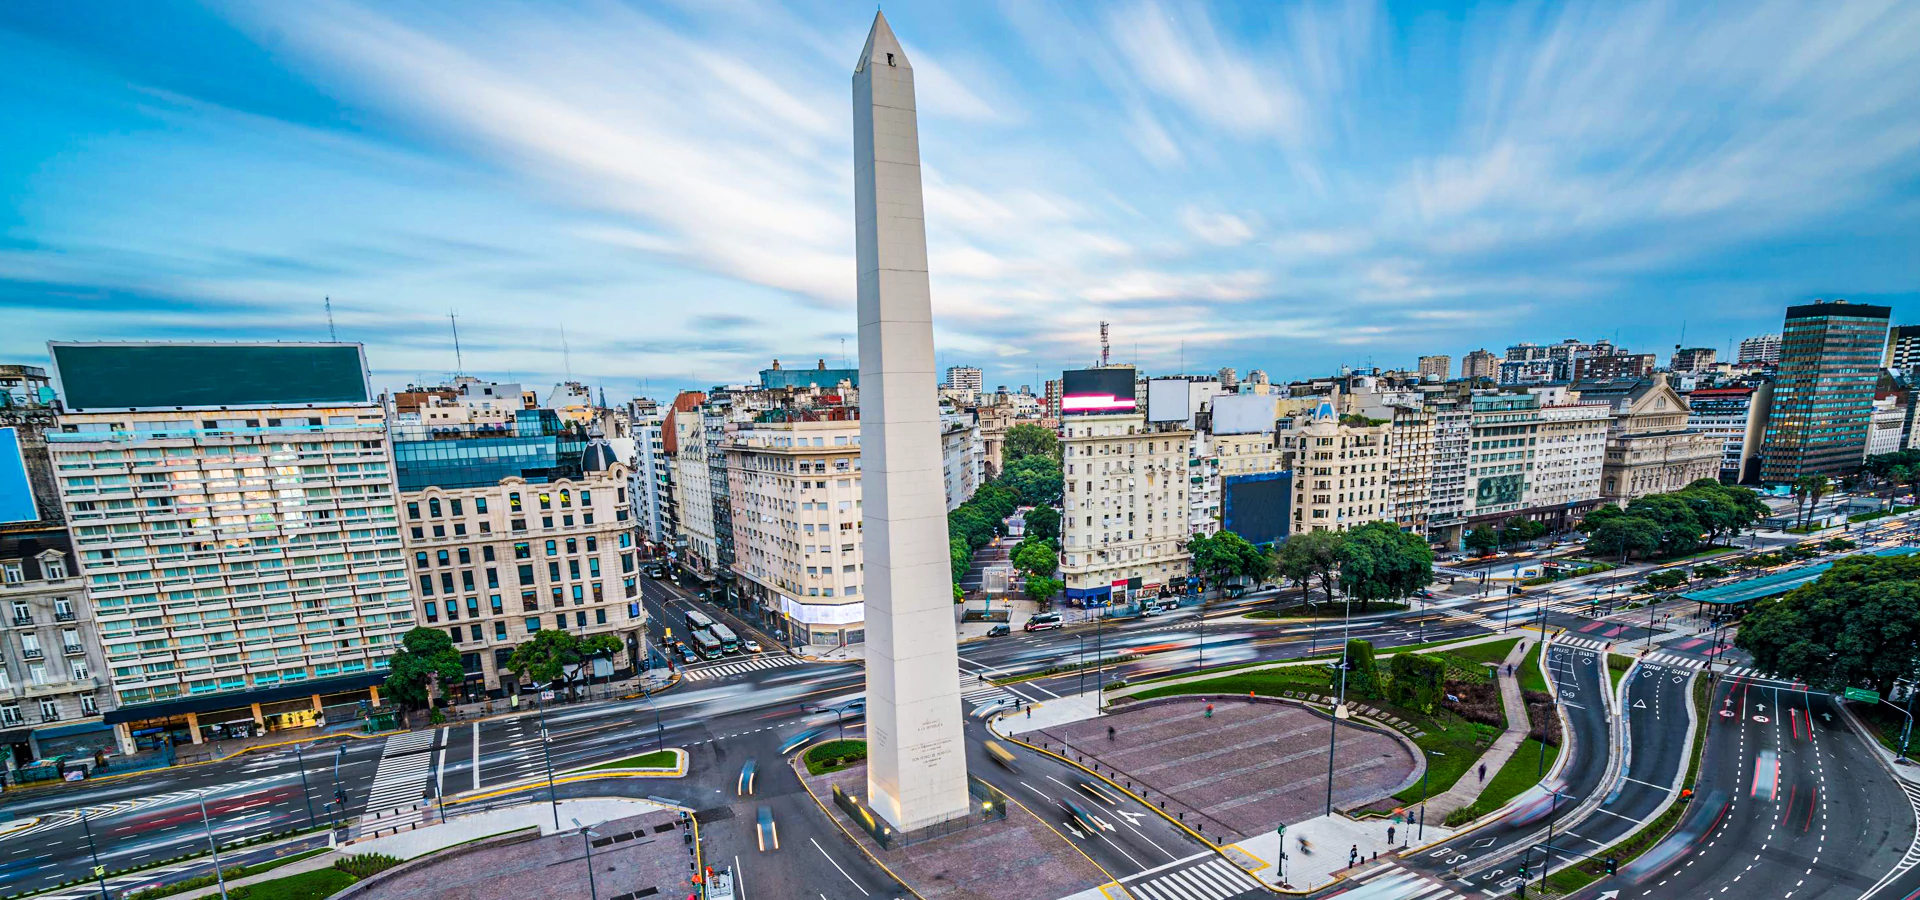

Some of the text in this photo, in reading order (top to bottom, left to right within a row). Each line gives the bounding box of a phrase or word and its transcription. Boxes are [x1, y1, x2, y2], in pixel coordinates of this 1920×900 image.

[1642, 663, 1662, 671] BUS
[1671, 668, 1691, 677] BUS
[1561, 689, 1575, 699] 59
